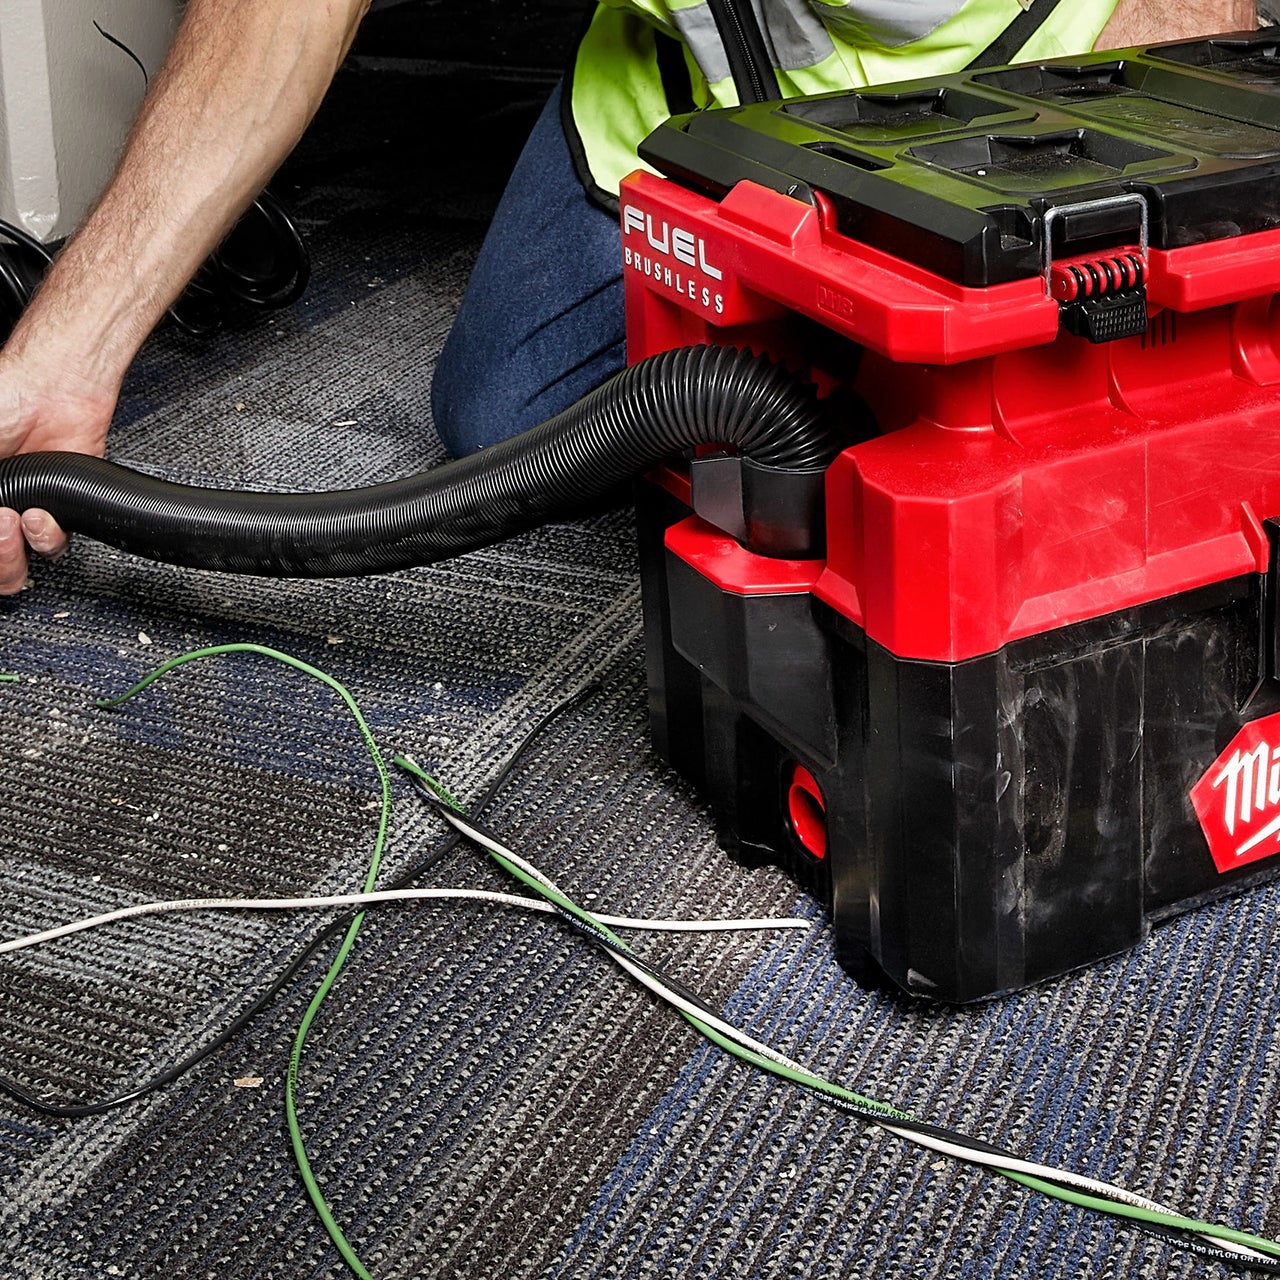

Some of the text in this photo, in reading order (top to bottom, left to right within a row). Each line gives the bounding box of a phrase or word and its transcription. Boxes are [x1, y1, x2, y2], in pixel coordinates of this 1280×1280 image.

[623, 204, 723, 281] FUEL
[624, 246, 724, 315] BRUSHLESS
[1207, 1248, 1239, 1261] NYLON
